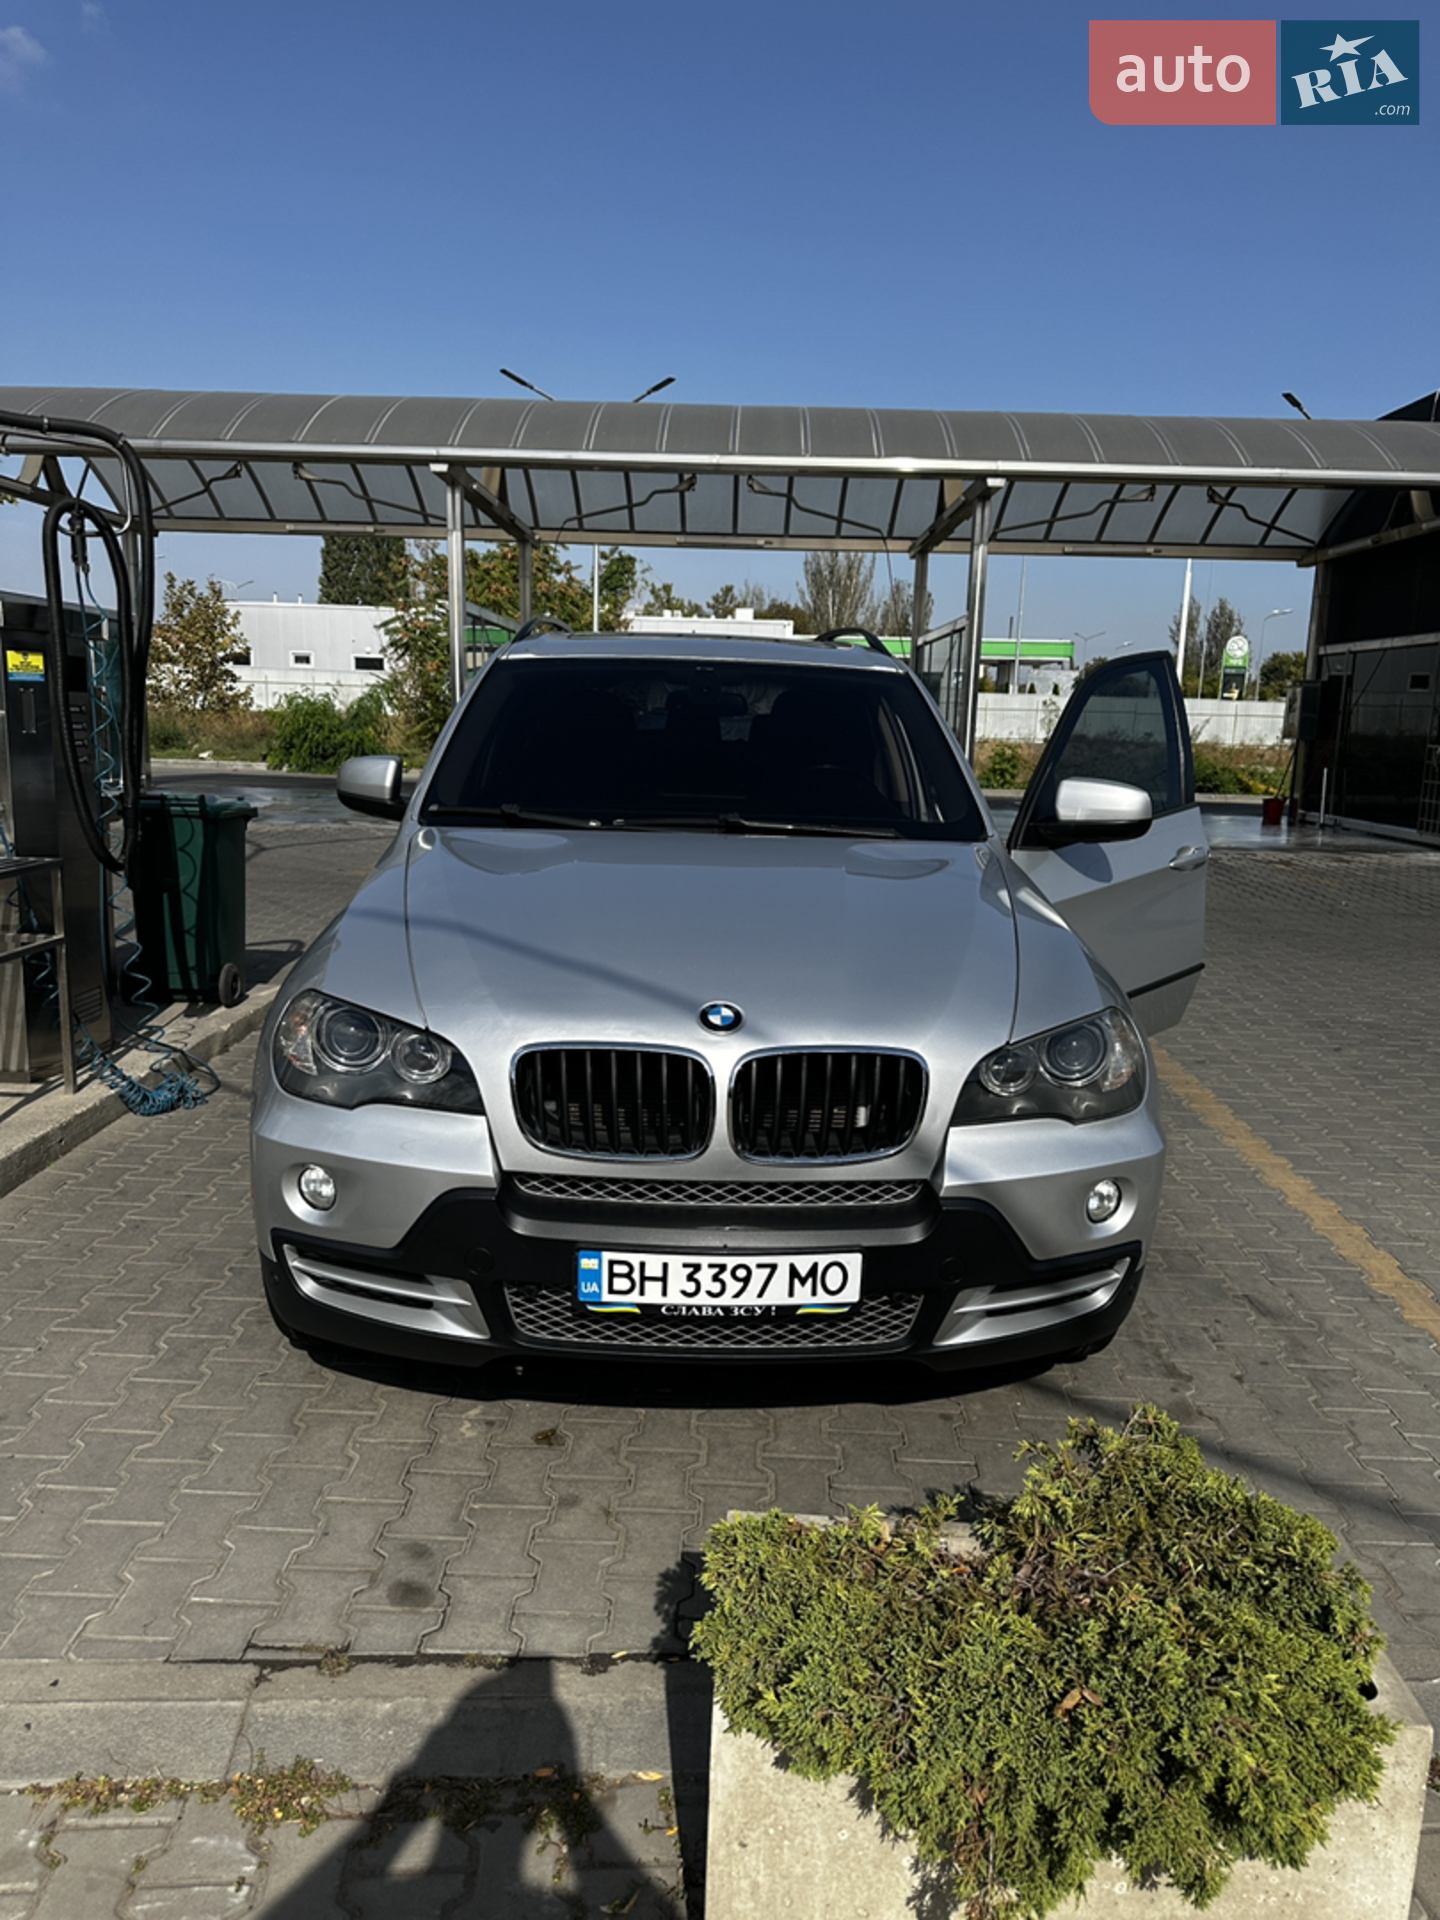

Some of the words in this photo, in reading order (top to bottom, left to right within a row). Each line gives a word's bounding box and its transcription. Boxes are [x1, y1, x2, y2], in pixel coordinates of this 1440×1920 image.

[607, 1259, 669, 1297] BH
[678, 1262, 778, 1299] 3397
[788, 1260, 849, 1298] MO
[581, 1281, 600, 1294] UA
[660, 1305, 724, 1317] СЛАВА
